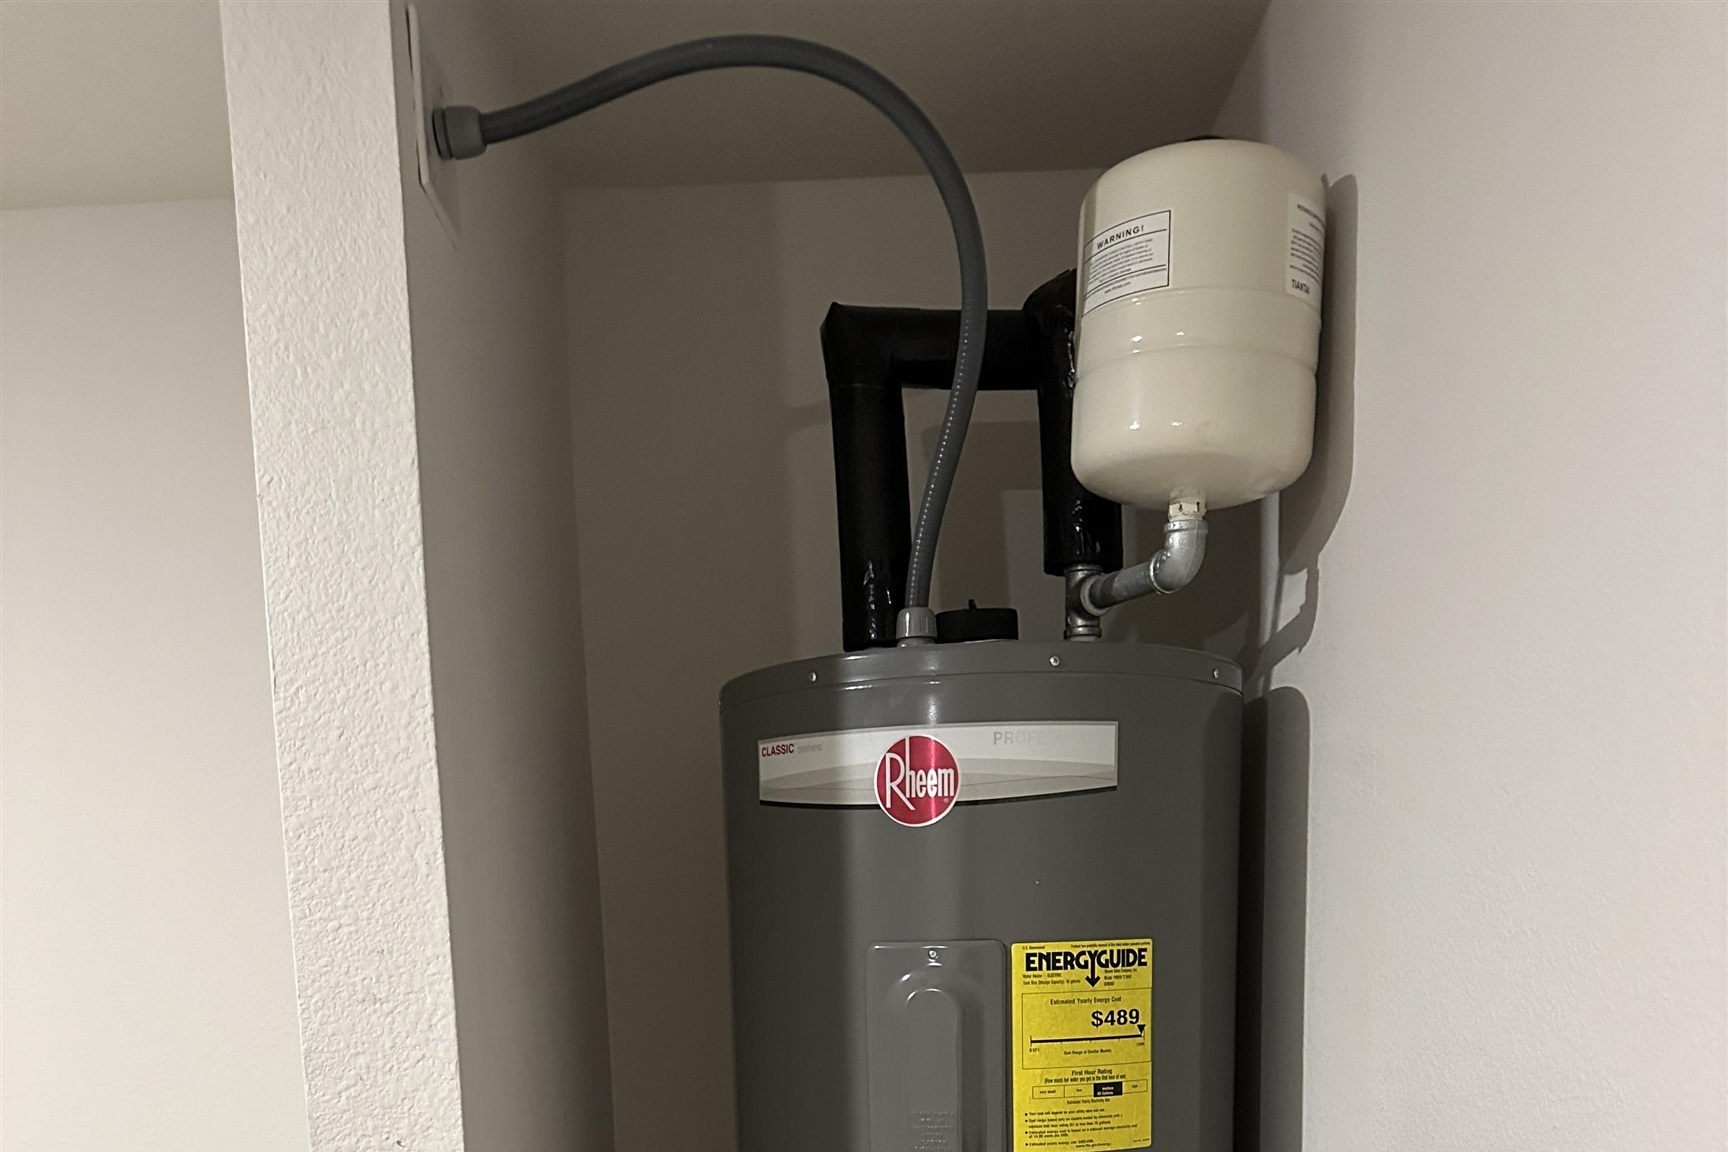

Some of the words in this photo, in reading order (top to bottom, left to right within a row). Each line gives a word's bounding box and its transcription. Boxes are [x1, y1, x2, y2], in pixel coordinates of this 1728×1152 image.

[1097, 225, 1144, 249] WARNING!
[762, 743, 794, 757] CLASSIC
[885, 736, 955, 811] Rheem
[1025, 948, 1148, 972] ENERGYGUIDE
[1091, 1009, 1140, 1028] $489
